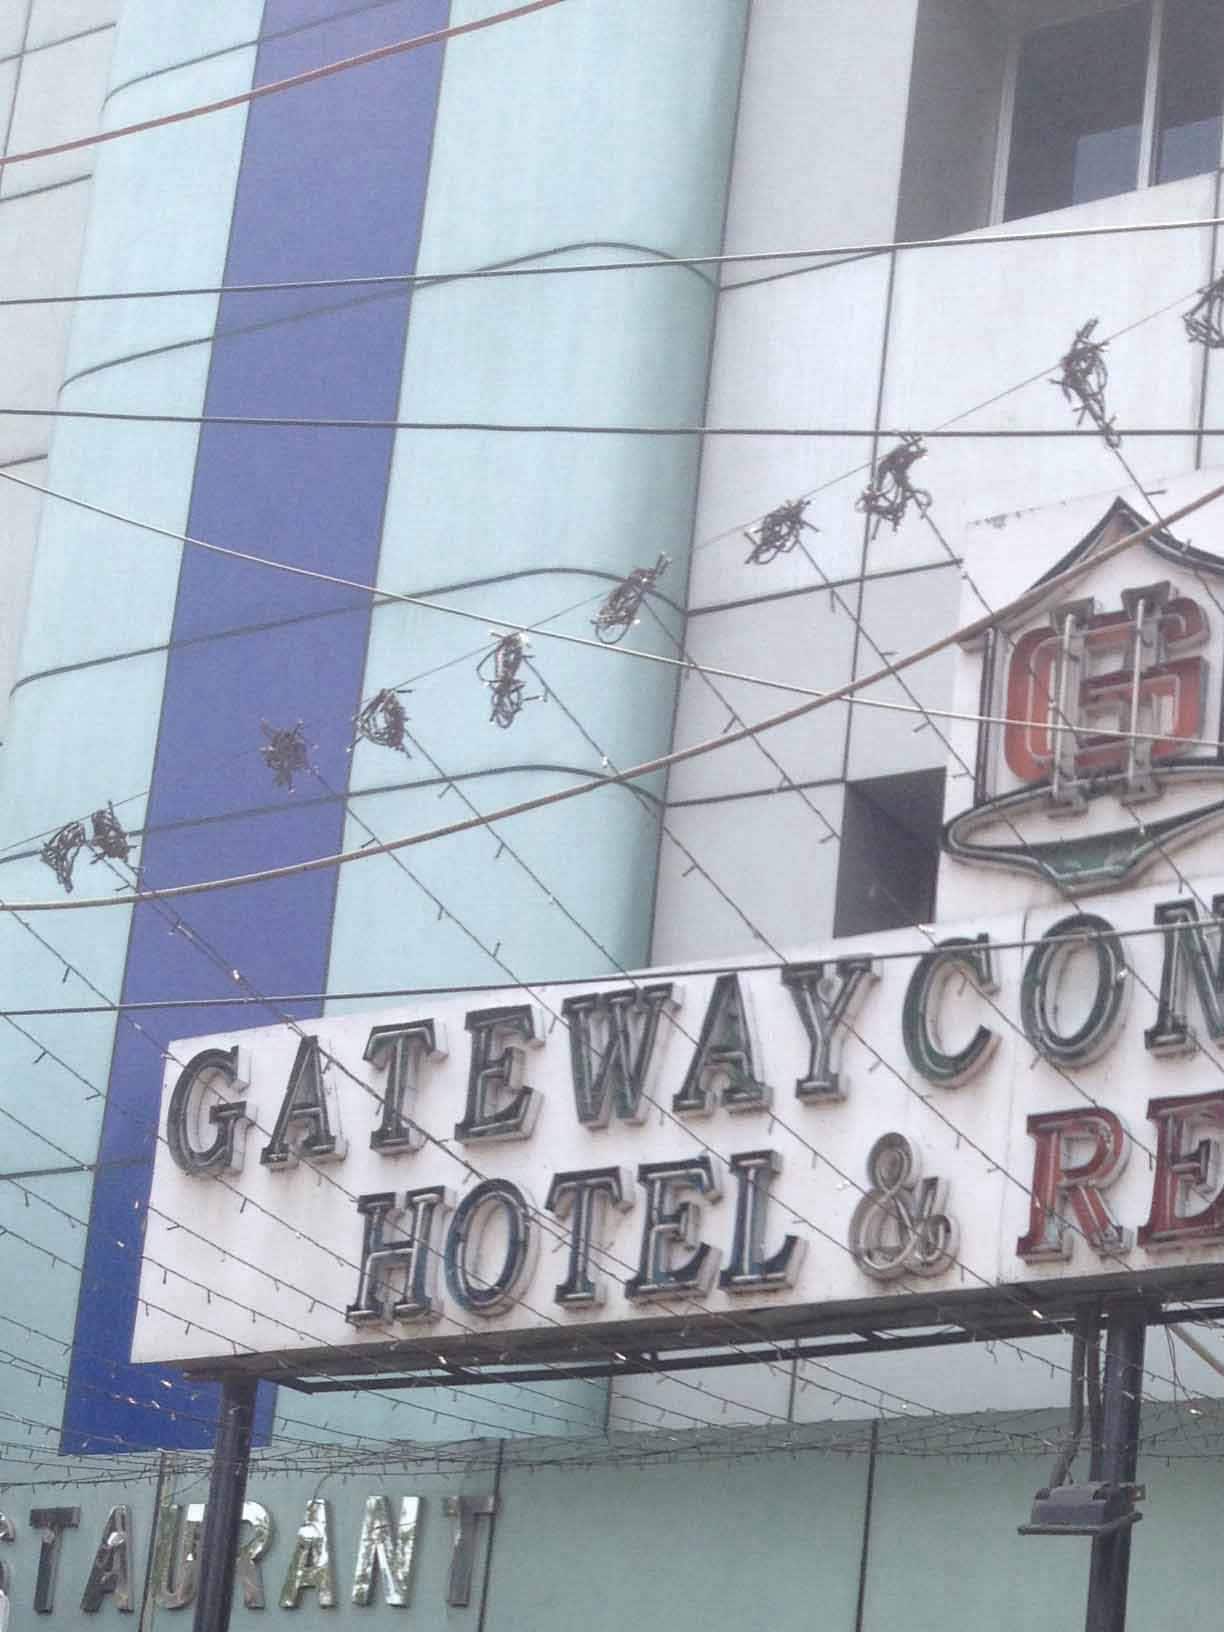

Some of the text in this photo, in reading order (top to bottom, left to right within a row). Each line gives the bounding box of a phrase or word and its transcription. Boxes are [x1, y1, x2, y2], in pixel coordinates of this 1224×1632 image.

[166, 952, 882, 1177] GATEWAY
[345, 1149, 806, 1328] HOTEL
[848, 1131, 962, 1282] &
